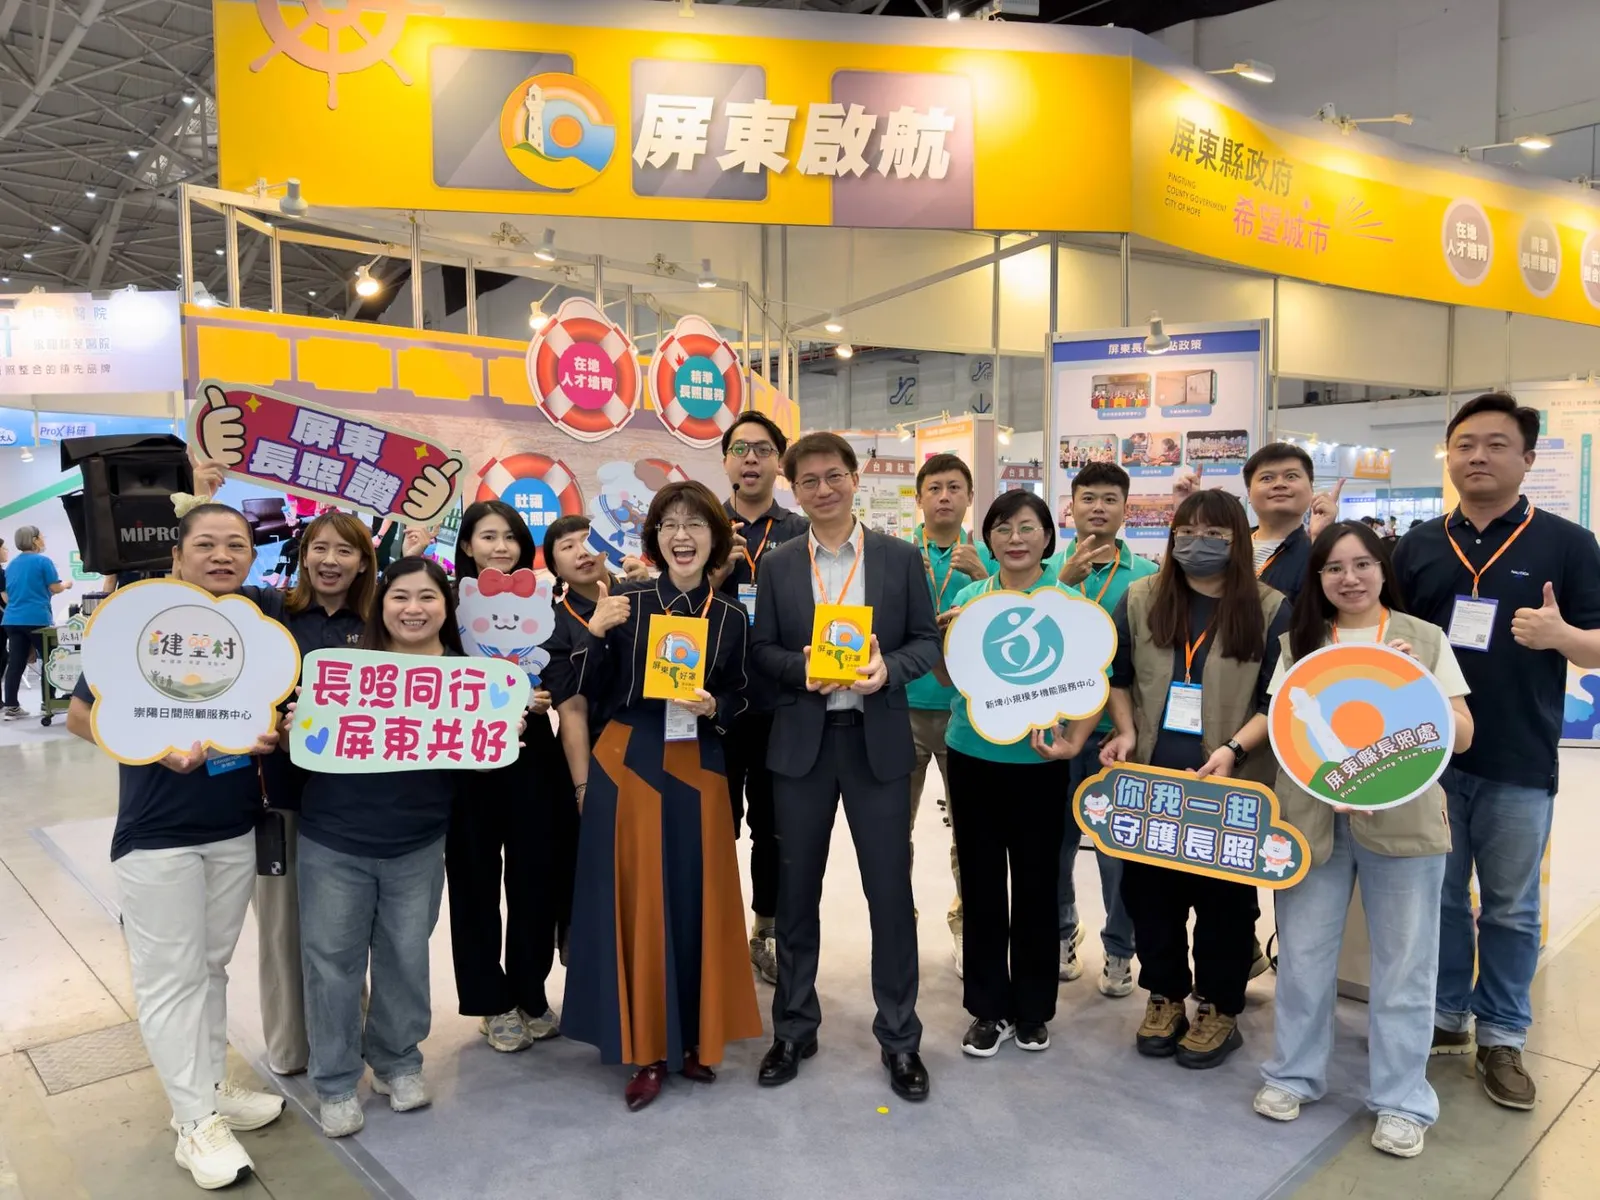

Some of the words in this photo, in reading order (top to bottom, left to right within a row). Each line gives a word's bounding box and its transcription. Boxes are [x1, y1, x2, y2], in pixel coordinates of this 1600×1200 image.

[632, 93, 955, 179] 屏東啟航
[1169, 115, 1294, 197] 屏東縣政府
[1166, 185, 1189, 199] COUNTY
[1190, 194, 1227, 212] GOVERNMENT
[1167, 172, 1196, 189] PINGTUNG
[1164, 197, 1178, 208] CITY
[1186, 205, 1201, 217] HOPE
[1232, 194, 1330, 255] 希望城市
[1455, 220, 1478, 242] 在地
[561, 371, 613, 392] 人才培育
[574, 356, 600, 373] 在地
[40, 425, 65, 437] ProX
[291, 406, 386, 463] 屏東
[249, 438, 402, 515] 長照讚
[313, 660, 486, 712] 長照同行
[985, 679, 1095, 709] 新埤小規模多機能服務中心
[134, 707, 252, 721] 崇陽日間照顧服務中心
[335, 714, 508, 763] 屏東共好
[1325, 723, 1439, 791] 屏東縣長照處
[1115, 776, 1260, 831] 你我一起
[1111, 814, 1256, 869] 守護長照
